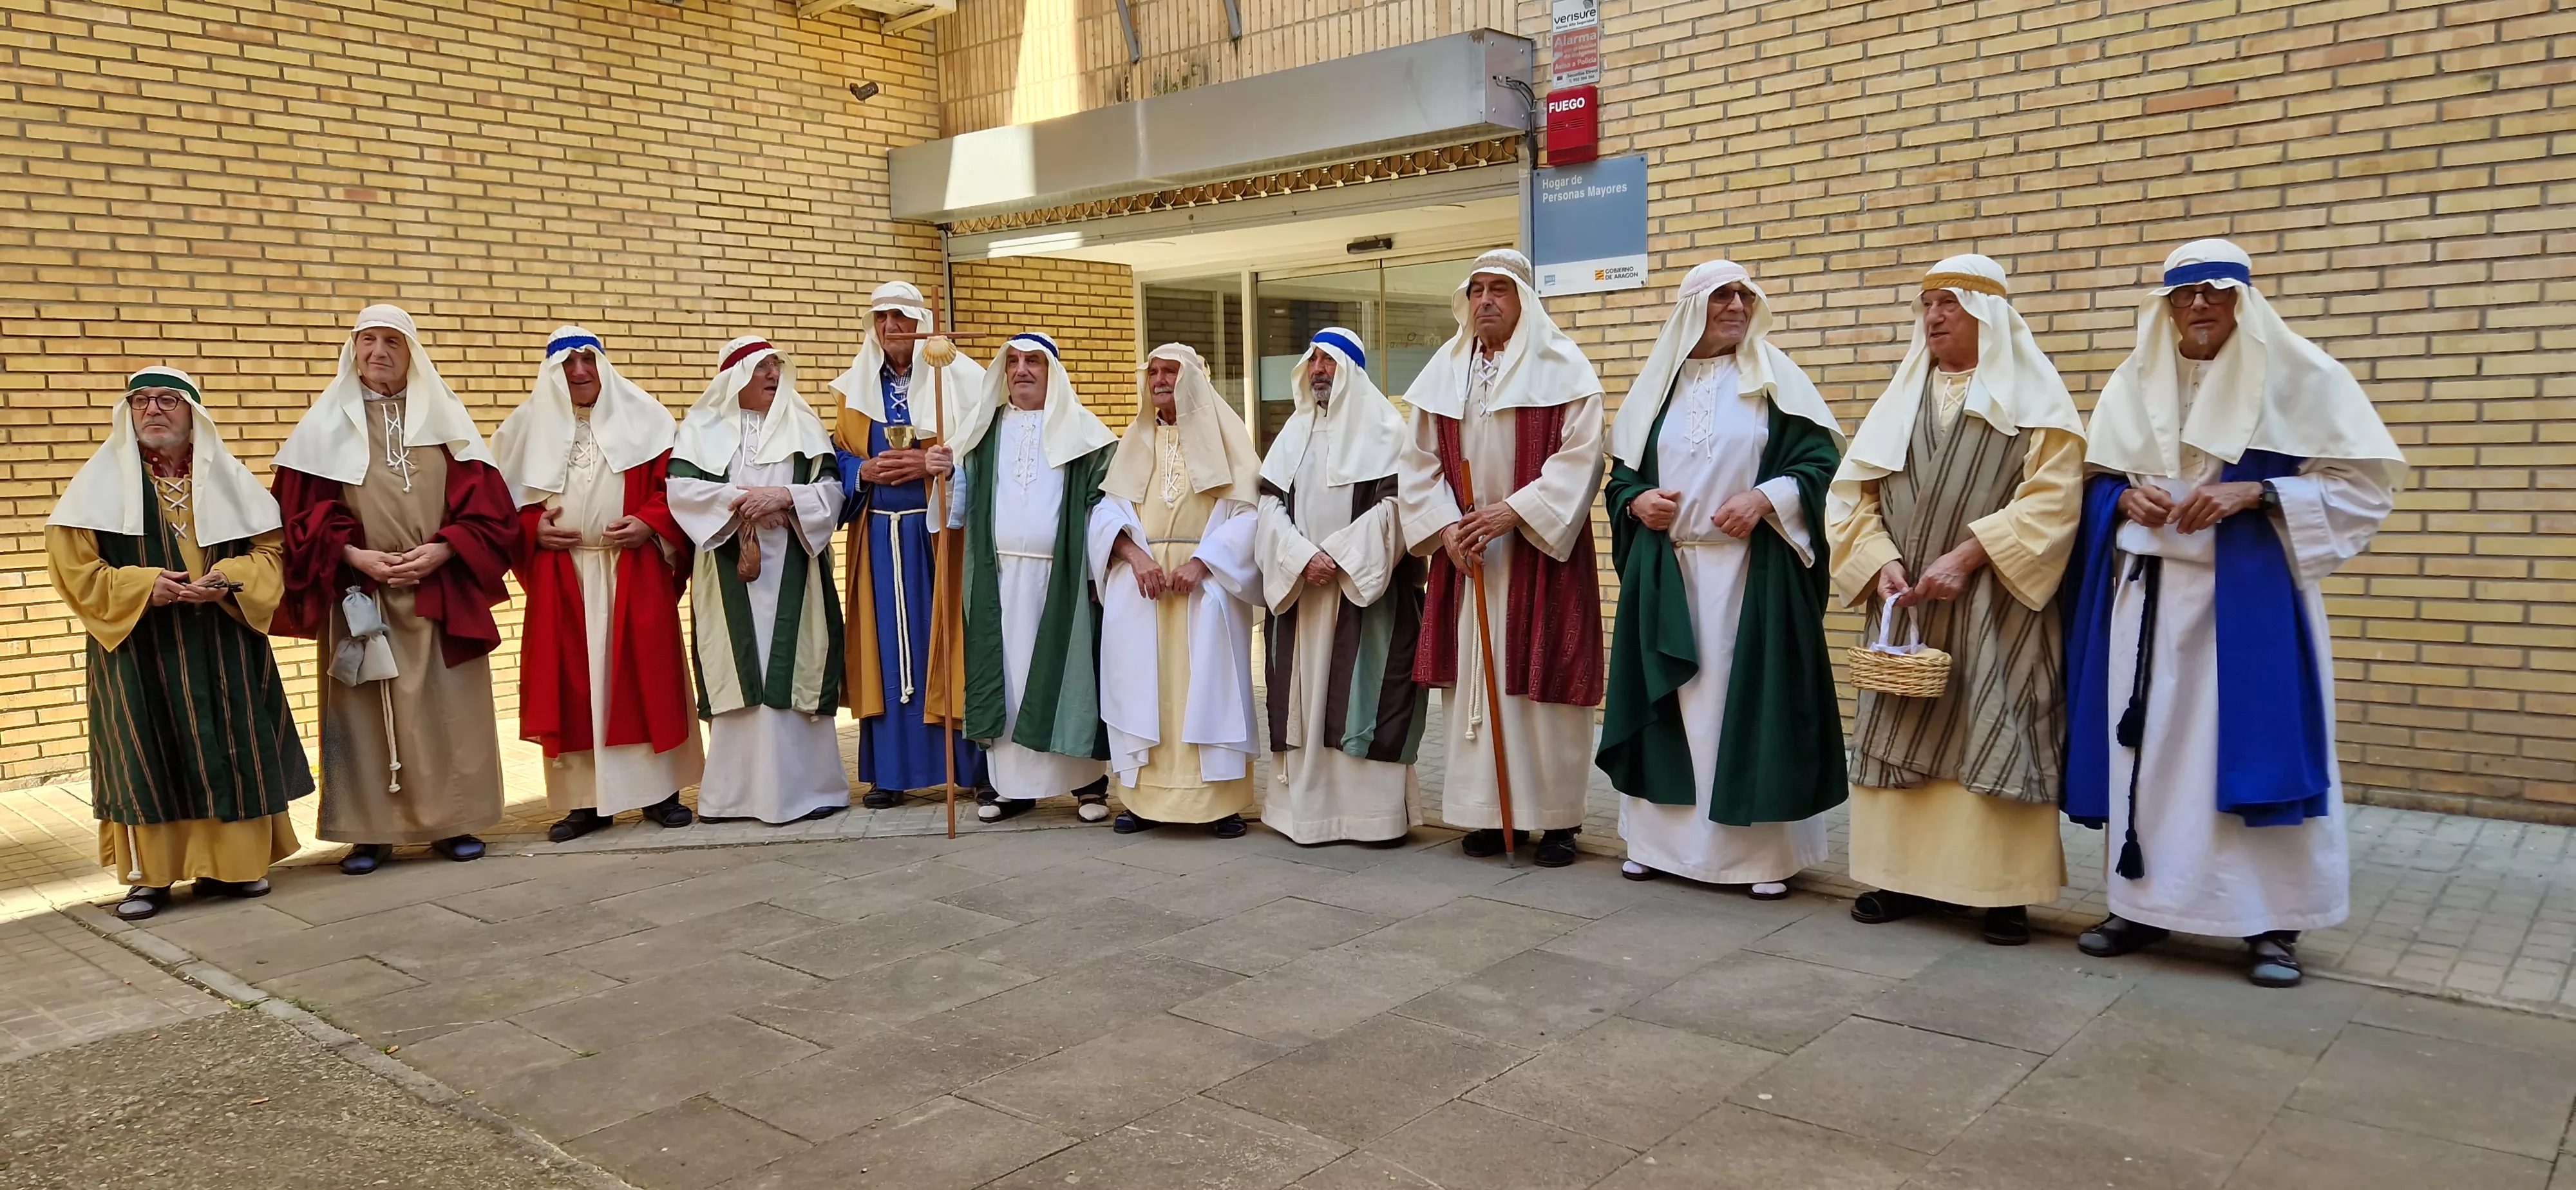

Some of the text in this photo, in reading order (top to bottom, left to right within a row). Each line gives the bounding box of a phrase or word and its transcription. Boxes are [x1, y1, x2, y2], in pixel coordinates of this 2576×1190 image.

[1554, 9, 1596, 24] verisure
[1554, 32, 1596, 48] Alarma
[1577, 57, 1596, 66] Policía
[1549, 97, 1586, 113] FUEGO
[1542, 175, 1582, 190] Hogar de
[1542, 183, 1627, 203] Personas Mayores
